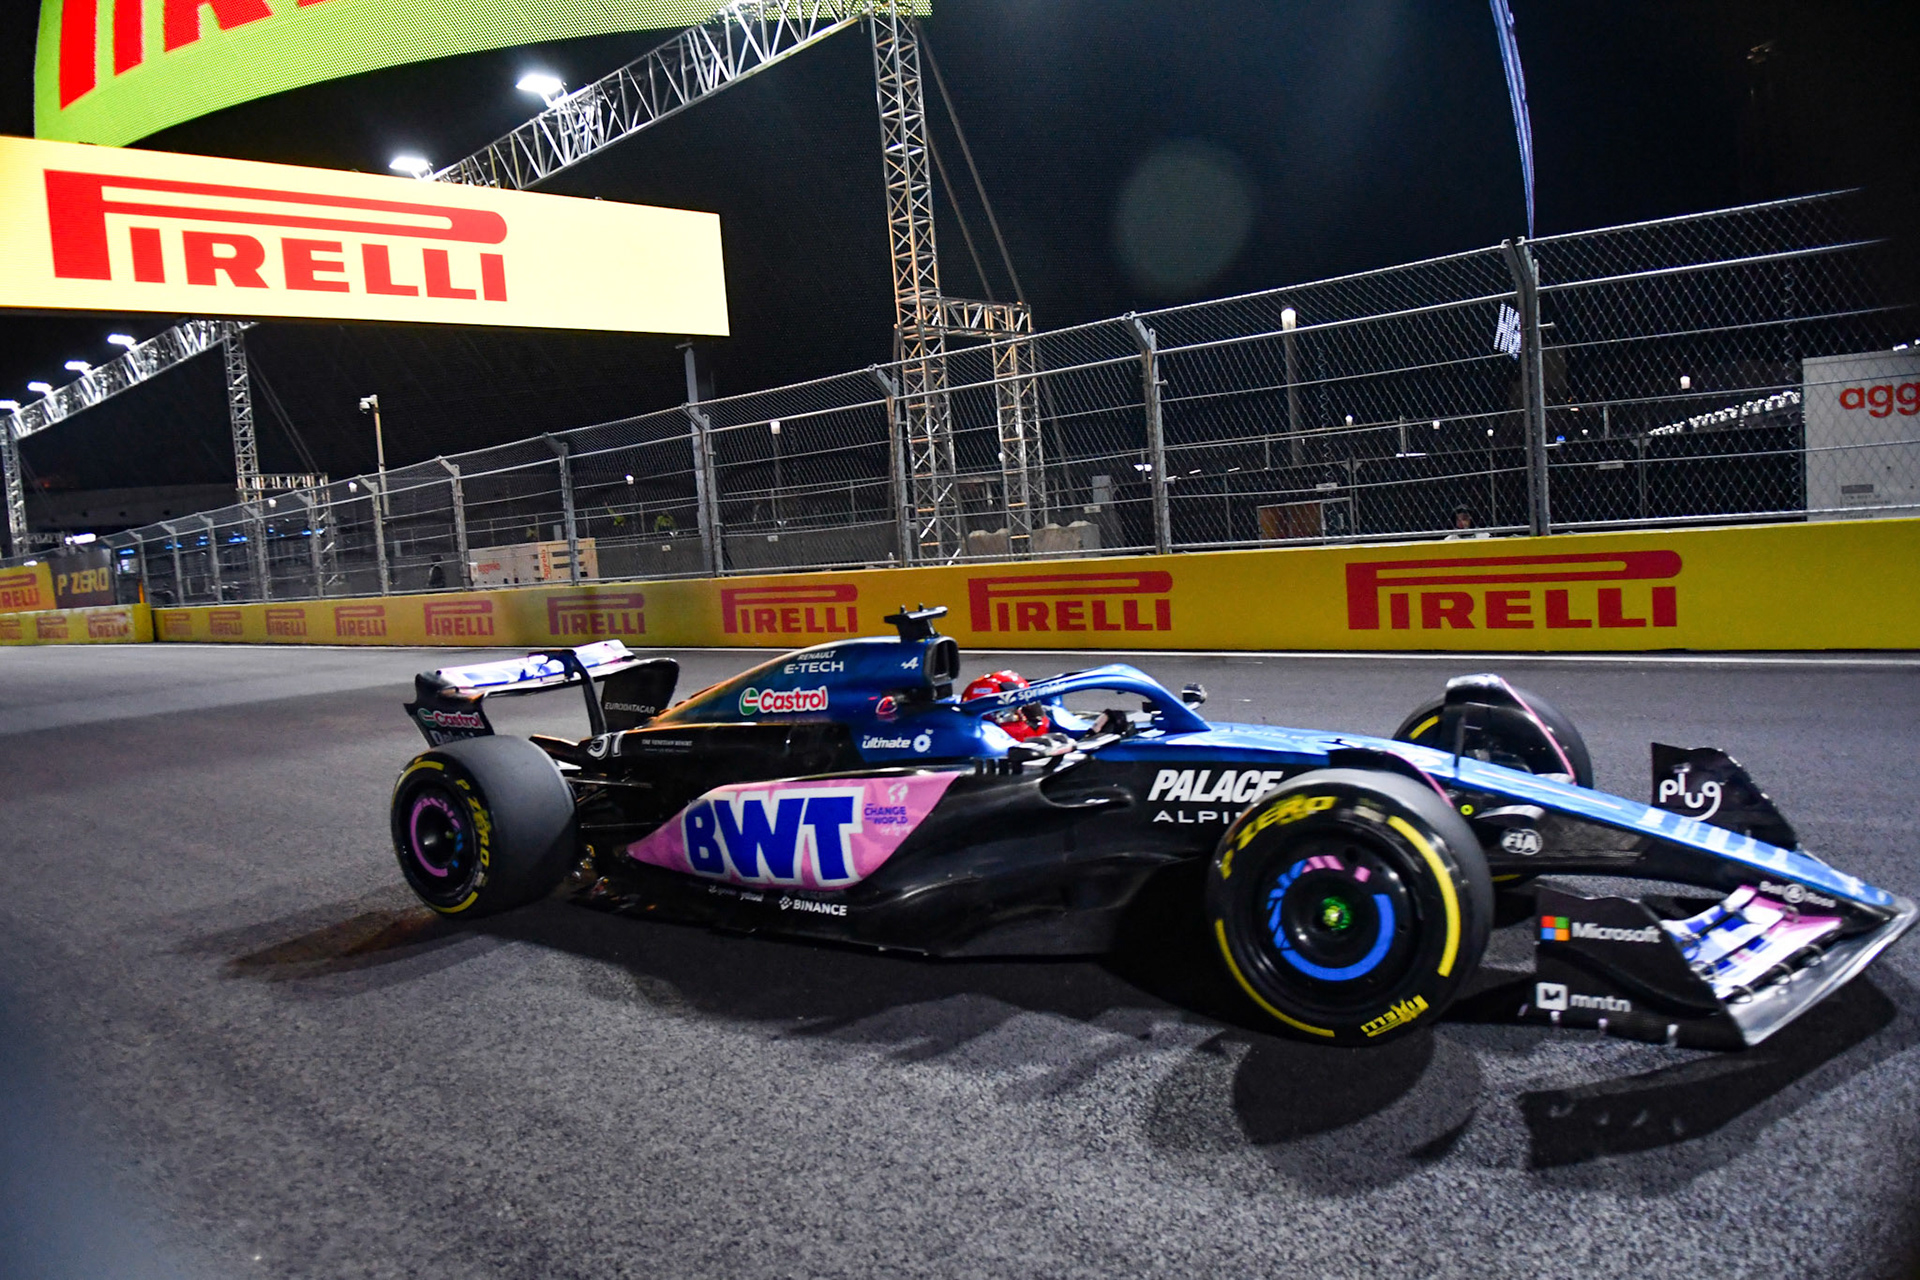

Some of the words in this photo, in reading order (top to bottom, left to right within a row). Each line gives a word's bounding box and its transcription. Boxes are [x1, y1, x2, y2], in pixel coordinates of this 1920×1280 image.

[43, 169, 507, 302] PIRELLI
[0, 573, 40, 608] RELLI
[57, 573, 68, 596] P
[70, 566, 109, 595] ZERO
[1345, 550, 1682, 630] PIRELLI
[547, 593, 645, 636] PIRELLI
[721, 584, 858, 634] PIRELLI
[968, 571, 1173, 632] PIRELLI
[265, 609, 307, 636] PIRELLI
[335, 605, 387, 637] PIRELLI
[424, 601, 494, 636] PIRELLI
[783, 661, 845, 674] E-TECH
[797, 650, 836, 661] RENAULT
[604, 702, 656, 714] EURODATACAR
[758, 686, 828, 713] Castrol
[433, 710, 485, 729] Castrol
[862, 736, 911, 749] ultimate
[1148, 769, 1283, 802] PALACE
[1659, 771, 1722, 821] plug
[864, 806, 906, 816] CHANGE
[873, 816, 908, 824] WORLD
[1152, 810, 1243, 824] ALPI
[683, 788, 862, 885] BWT
[1503, 832, 1538, 850] FIA
[793, 899, 848, 916] BINANCE
[1571, 921, 1661, 944] Microsoft
[1360, 994, 1430, 1037] PIRELLI
[1570, 993, 1632, 1013] mntn
